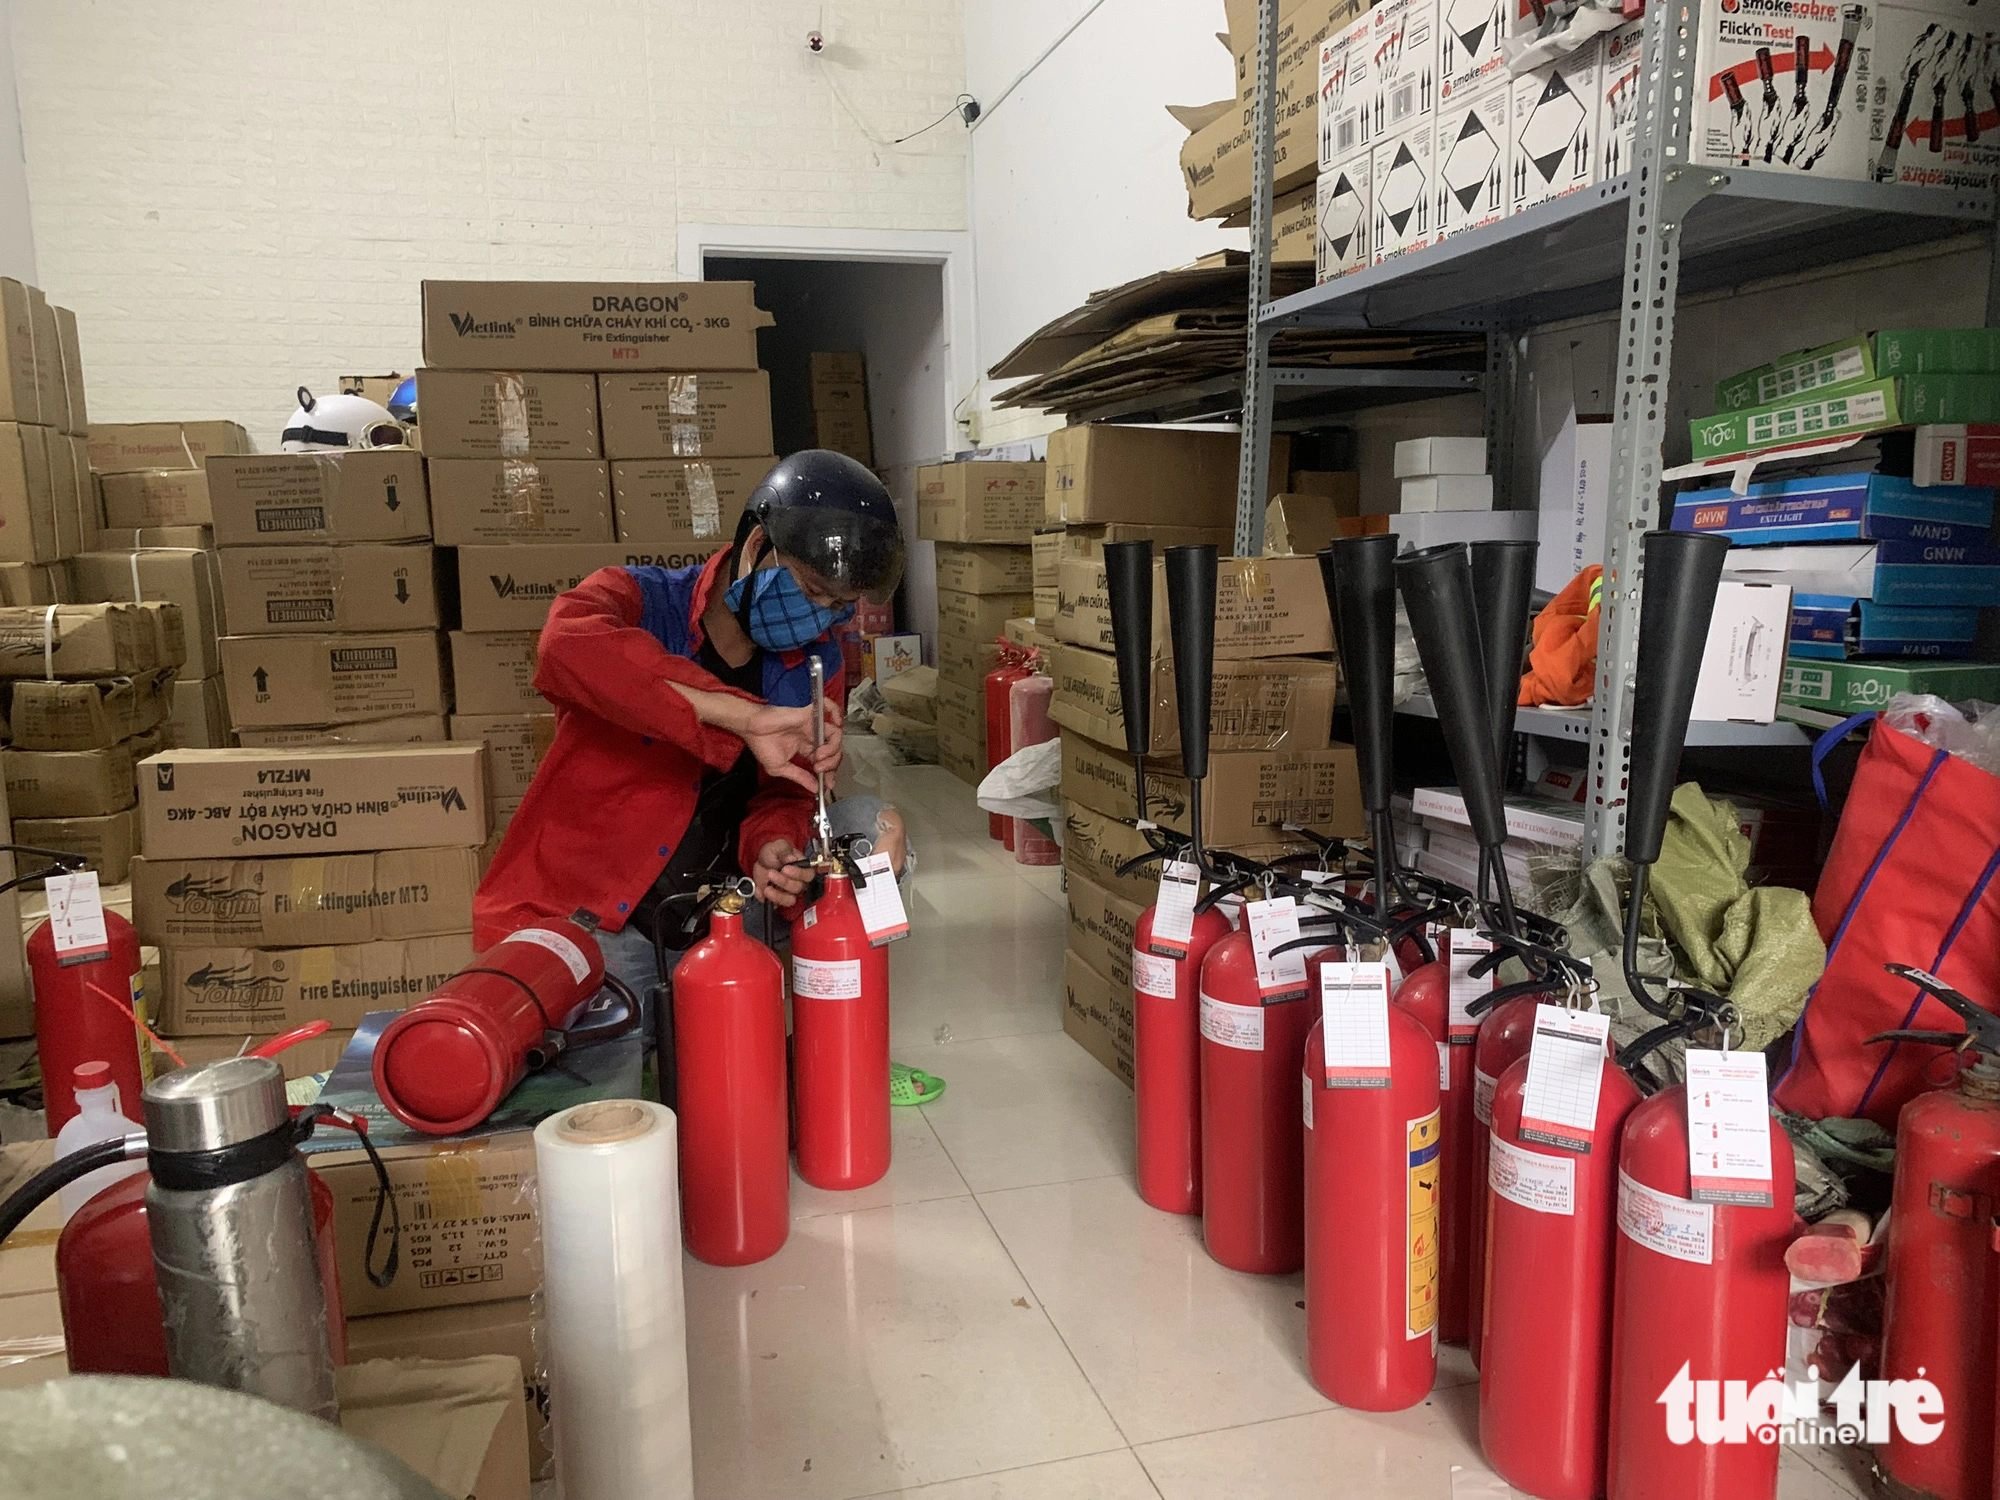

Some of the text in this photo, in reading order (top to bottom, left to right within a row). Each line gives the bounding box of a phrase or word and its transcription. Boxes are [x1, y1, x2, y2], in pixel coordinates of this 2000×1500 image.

[1720, 20, 1794, 39] Flick'n Test!
[1453, 55, 1504, 88] smokesabre
[593, 296, 679, 312] DRAGON
[529, 312, 559, 328] BÌNH
[563, 314, 602, 328] CHỮA
[605, 315, 641, 328] CHÁY
[645, 314, 667, 328] KHÍ
[704, 317, 730, 328] 3KG
[583, 333, 670, 344] Fire Extinguisher
[612, 348, 639, 359] MT3
[1943, 442, 1954, 479] GNVN
[382, 474, 398, 484] UP
[1694, 509, 1726, 526] GNVN
[1760, 512, 1804, 524] EXIT LIGHT
[1911, 524, 1952, 539] GNVN
[1924, 546, 1965, 561] GNVN
[393, 567, 408, 578] UP
[256, 693, 271, 703] UP
[257, 768, 310, 783] MFZL4
[242, 788, 324, 799] Fire Extinguisher
[239, 804, 267, 820] BỘT
[271, 804, 308, 818] CHÁY
[313, 803, 352, 818] CHỮA
[356, 801, 389, 815] BÌNH
[241, 821, 336, 842] DRAGON
[400, 885, 429, 904] MT3
[332, 974, 423, 1000] Extinguisher
[444, 1220, 457, 1228] 27
[410, 1234, 432, 1243] KGS
[410, 1246, 432, 1256] KGS
[448, 1243, 462, 1252] 12
[412, 1258, 432, 1268] PCS
